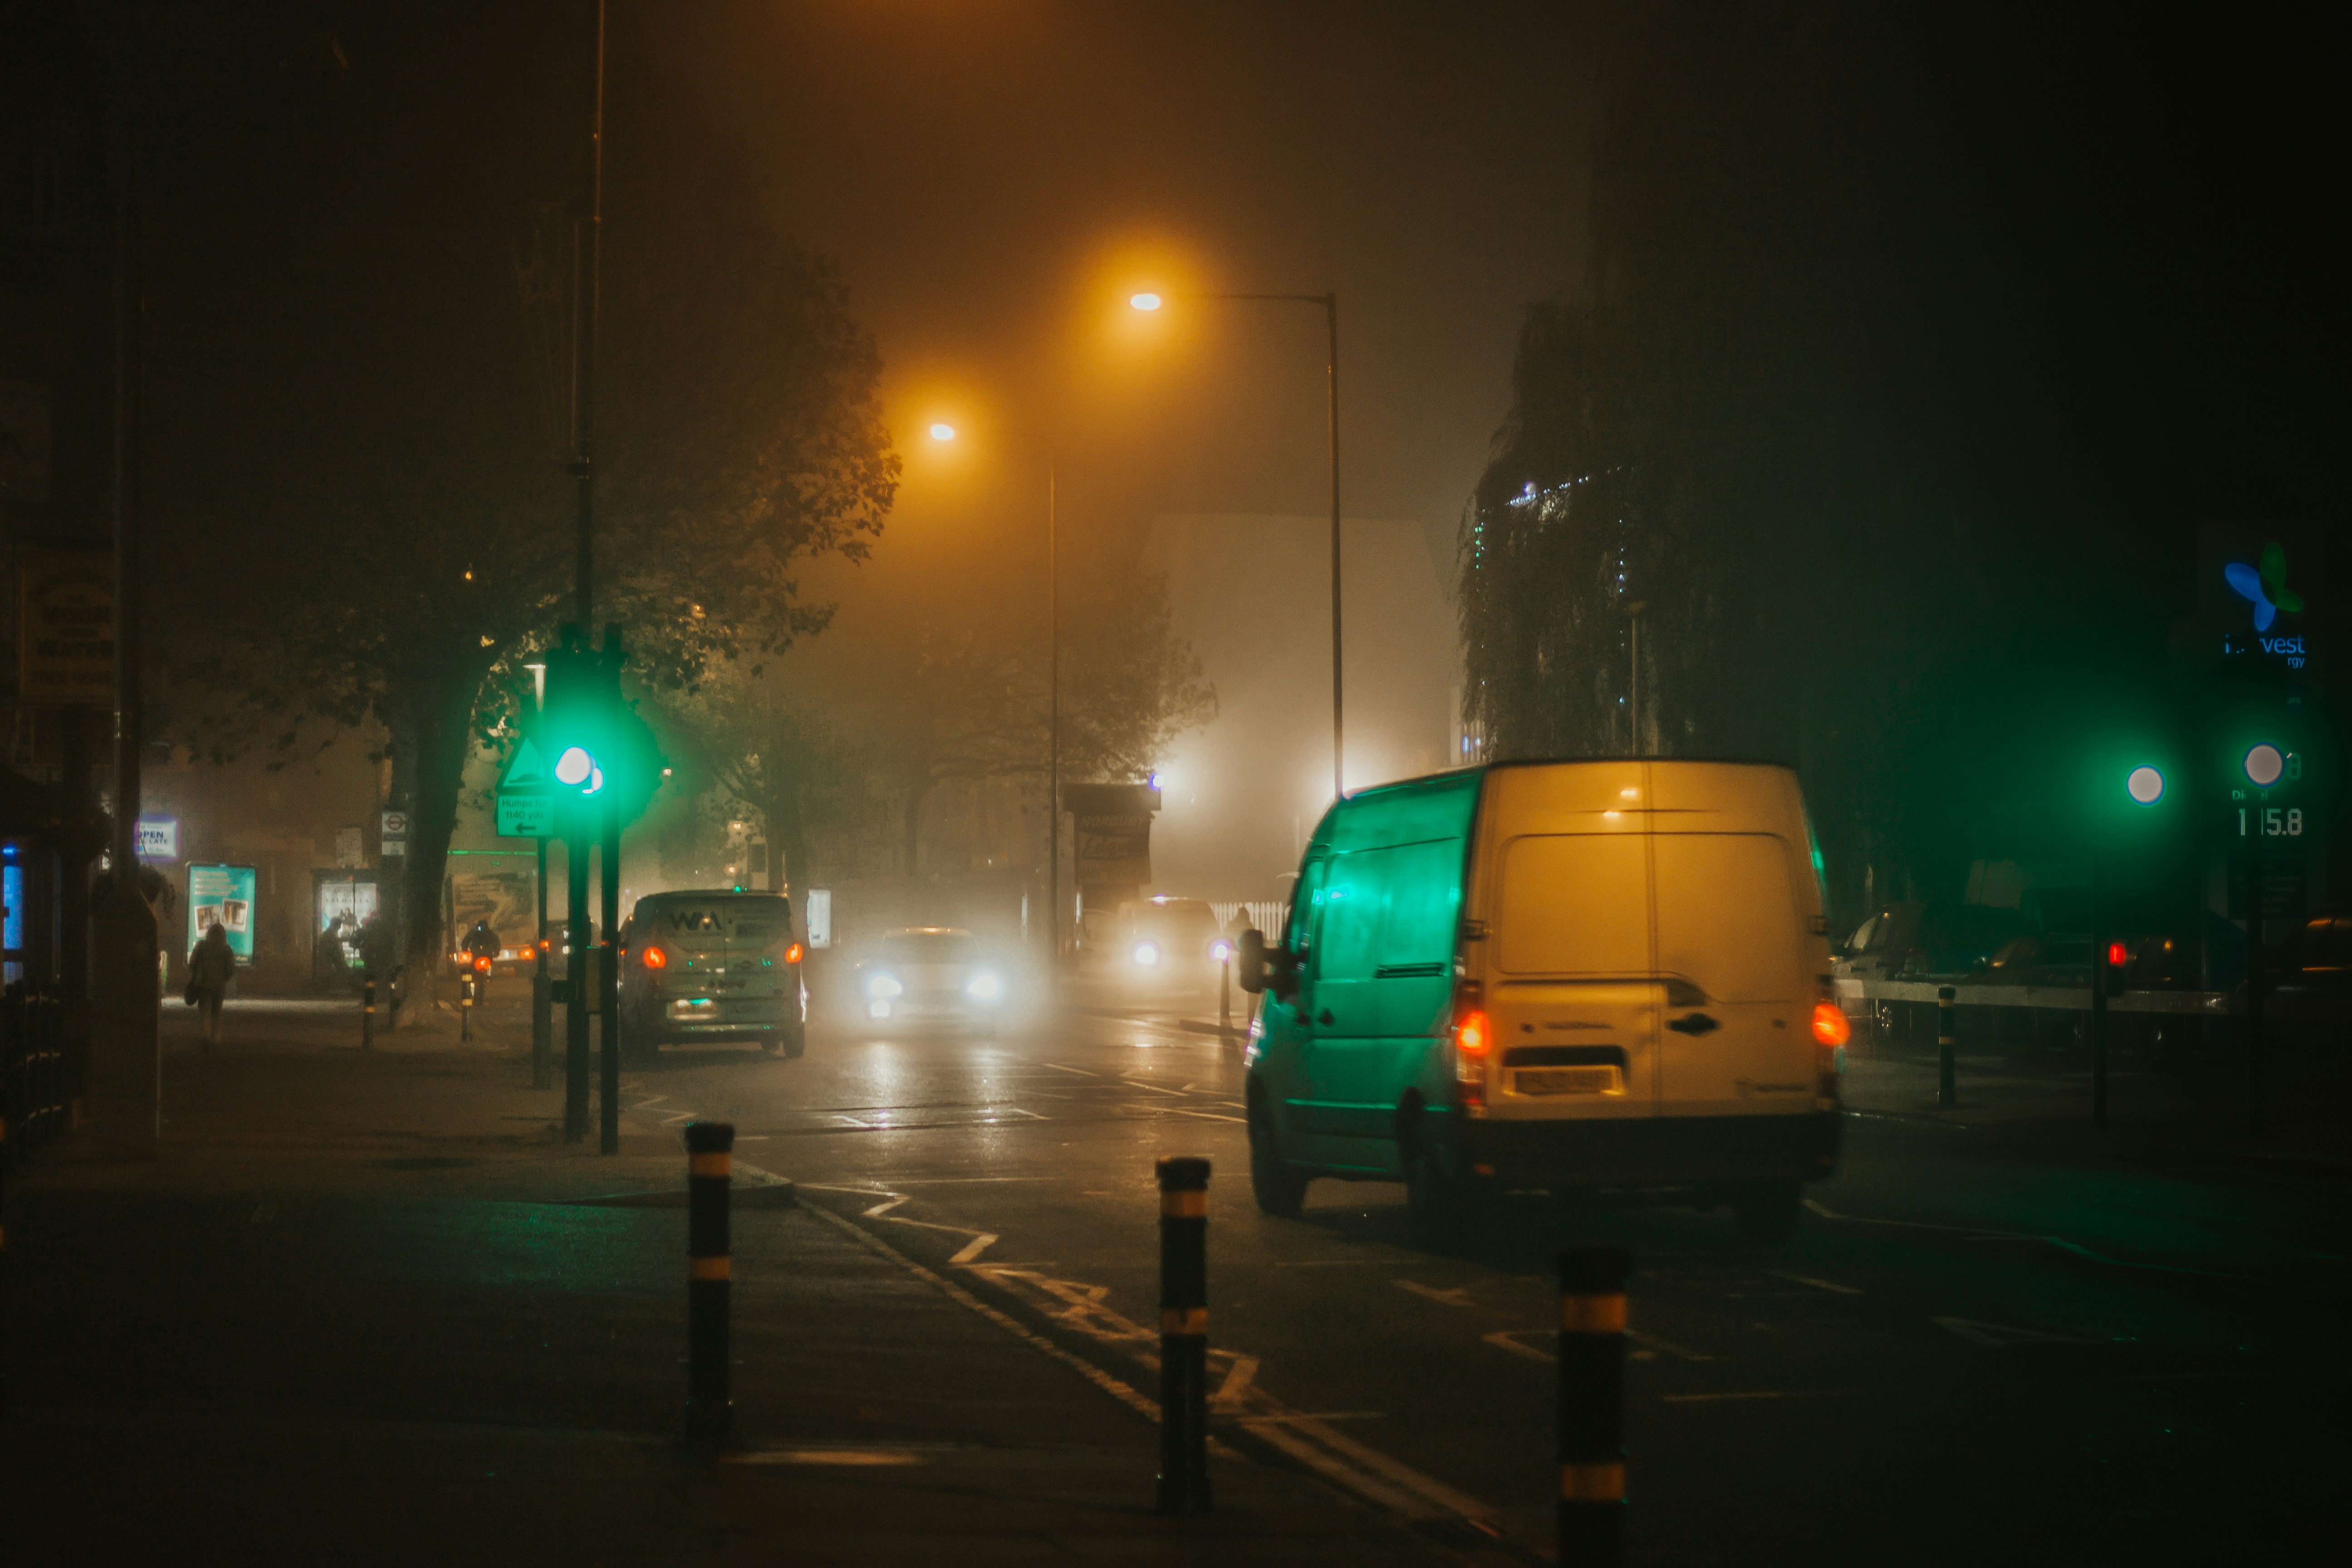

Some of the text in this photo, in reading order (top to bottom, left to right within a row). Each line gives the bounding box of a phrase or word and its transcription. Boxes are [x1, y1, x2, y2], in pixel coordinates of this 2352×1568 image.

[2288, 657, 2305, 669] rgy
[502, 799, 533, 807] Humps
[505, 811, 525, 819] 1140
